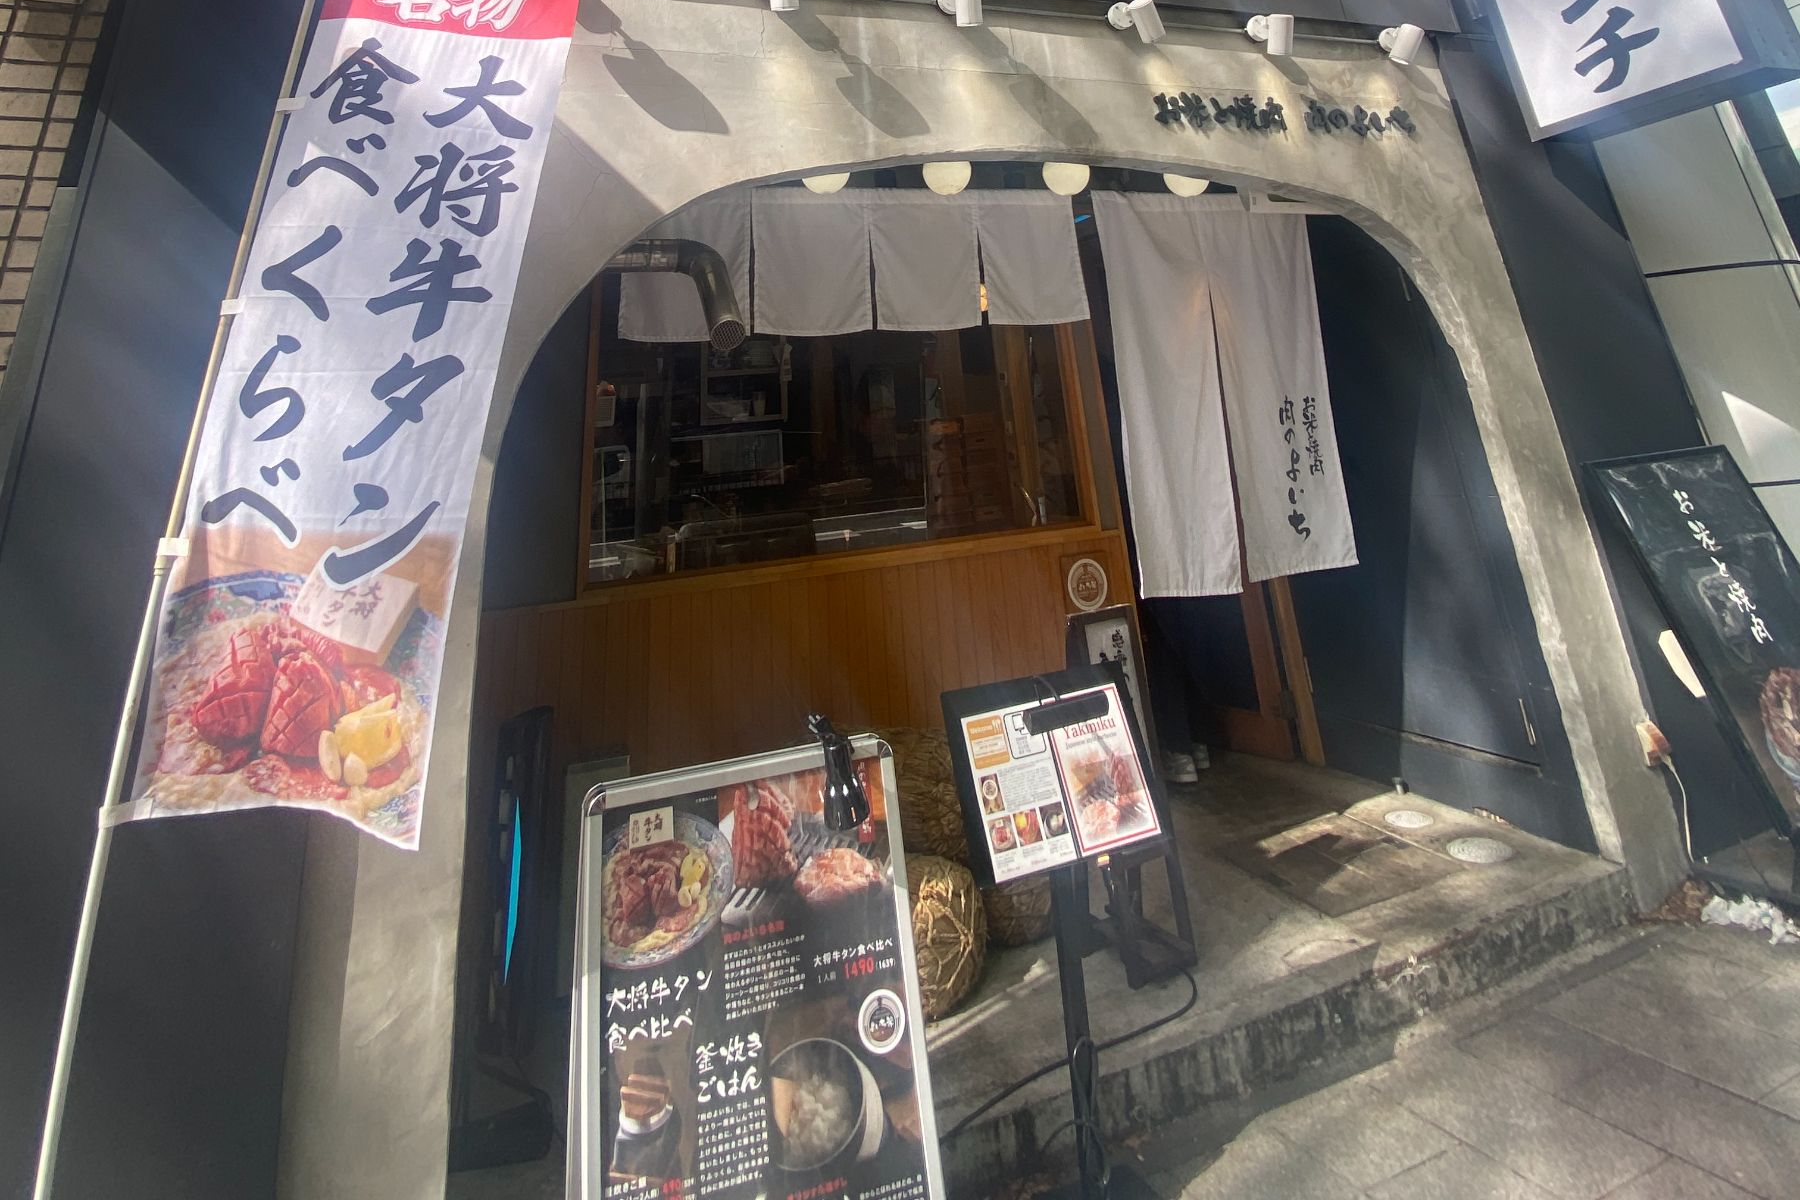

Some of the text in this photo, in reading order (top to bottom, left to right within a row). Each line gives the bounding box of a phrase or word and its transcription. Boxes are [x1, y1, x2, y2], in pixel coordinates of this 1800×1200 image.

[201, 38, 420, 549] 食べくらべ
[322, 55, 533, 586] 大将牛タン
[1279, 395, 1311, 542] 肉のよいち
[813, 937, 893, 968] 大将牛タン食べ比べ
[606, 970, 712, 1017] 大将牛タン
[605, 1007, 694, 1053] 食べ比べ
[696, 1032, 762, 1073] 釜炊き
[697, 1066, 762, 1102] ごはん
